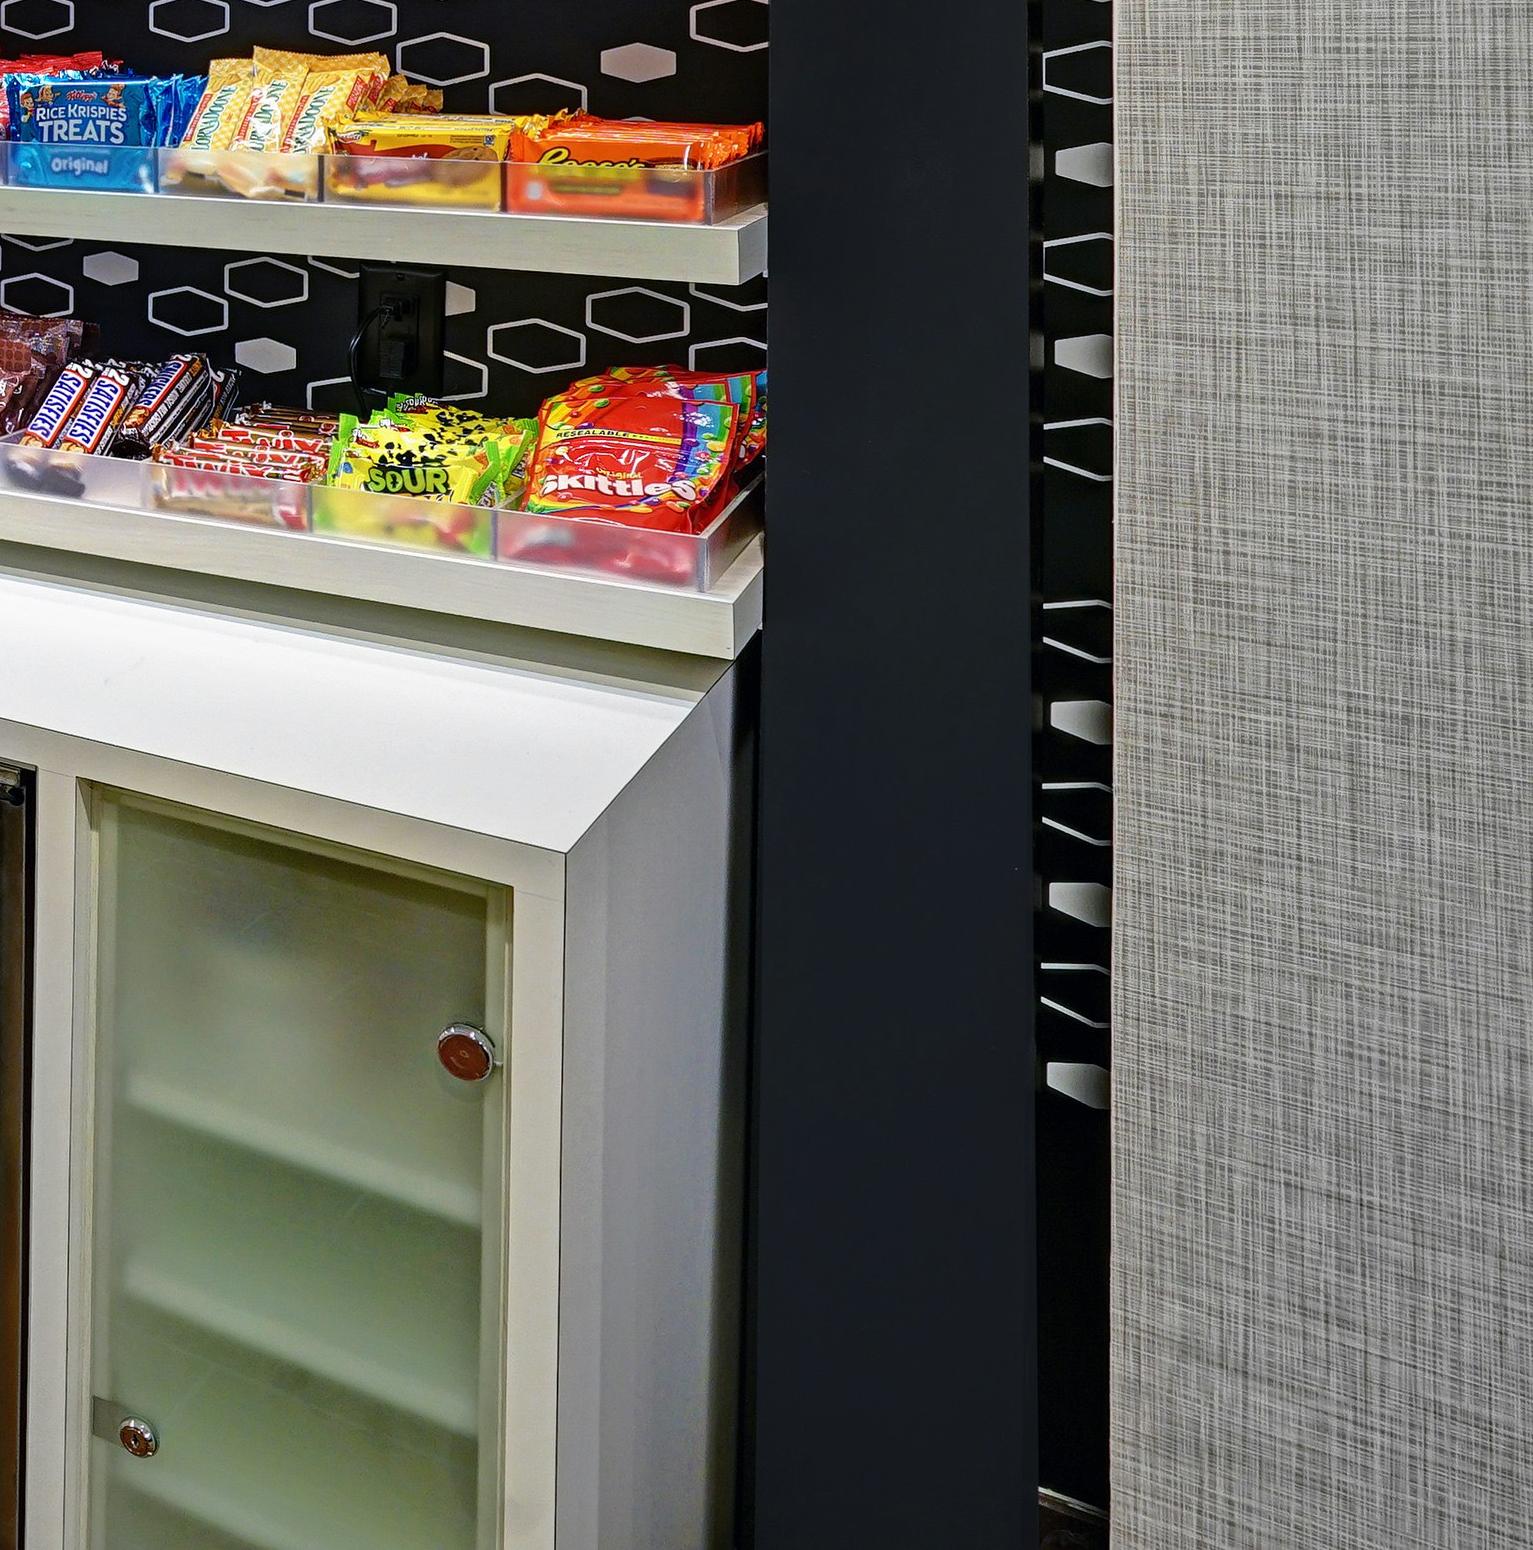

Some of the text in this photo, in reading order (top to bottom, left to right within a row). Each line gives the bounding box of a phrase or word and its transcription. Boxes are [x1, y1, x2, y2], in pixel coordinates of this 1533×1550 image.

[66, 90, 98, 102] Kellogg's
[35, 103, 127, 122] RICE KRISPIES
[39, 119, 125, 145] TREATS
[27, 372, 83, 440] SATISFIES
[69, 378, 120, 446] SATISFIES
[556, 429, 630, 439] RESEALABLE
[368, 466, 450, 494] SOUR
